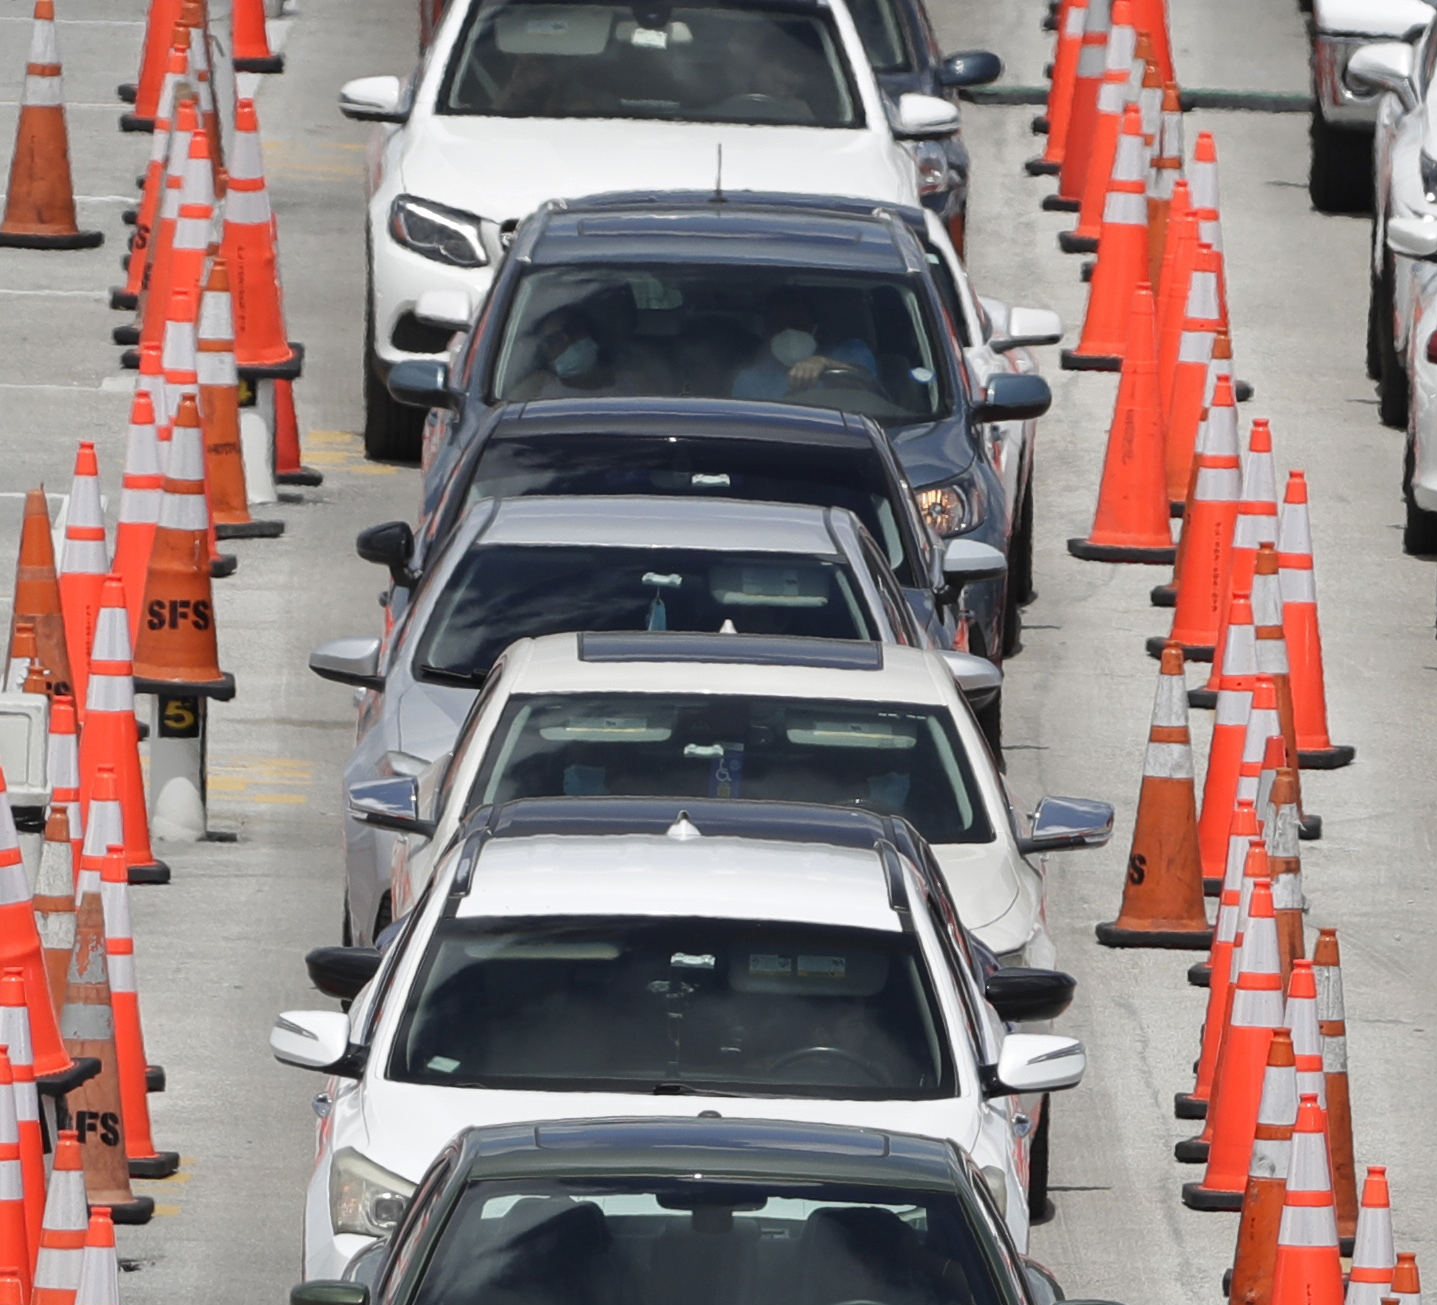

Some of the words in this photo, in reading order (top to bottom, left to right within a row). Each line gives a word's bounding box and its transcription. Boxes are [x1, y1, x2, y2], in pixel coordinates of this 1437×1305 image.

[146, 599, 210, 630] SFS
[163, 700, 195, 729] 5
[75, 1110, 120, 1147] FS
